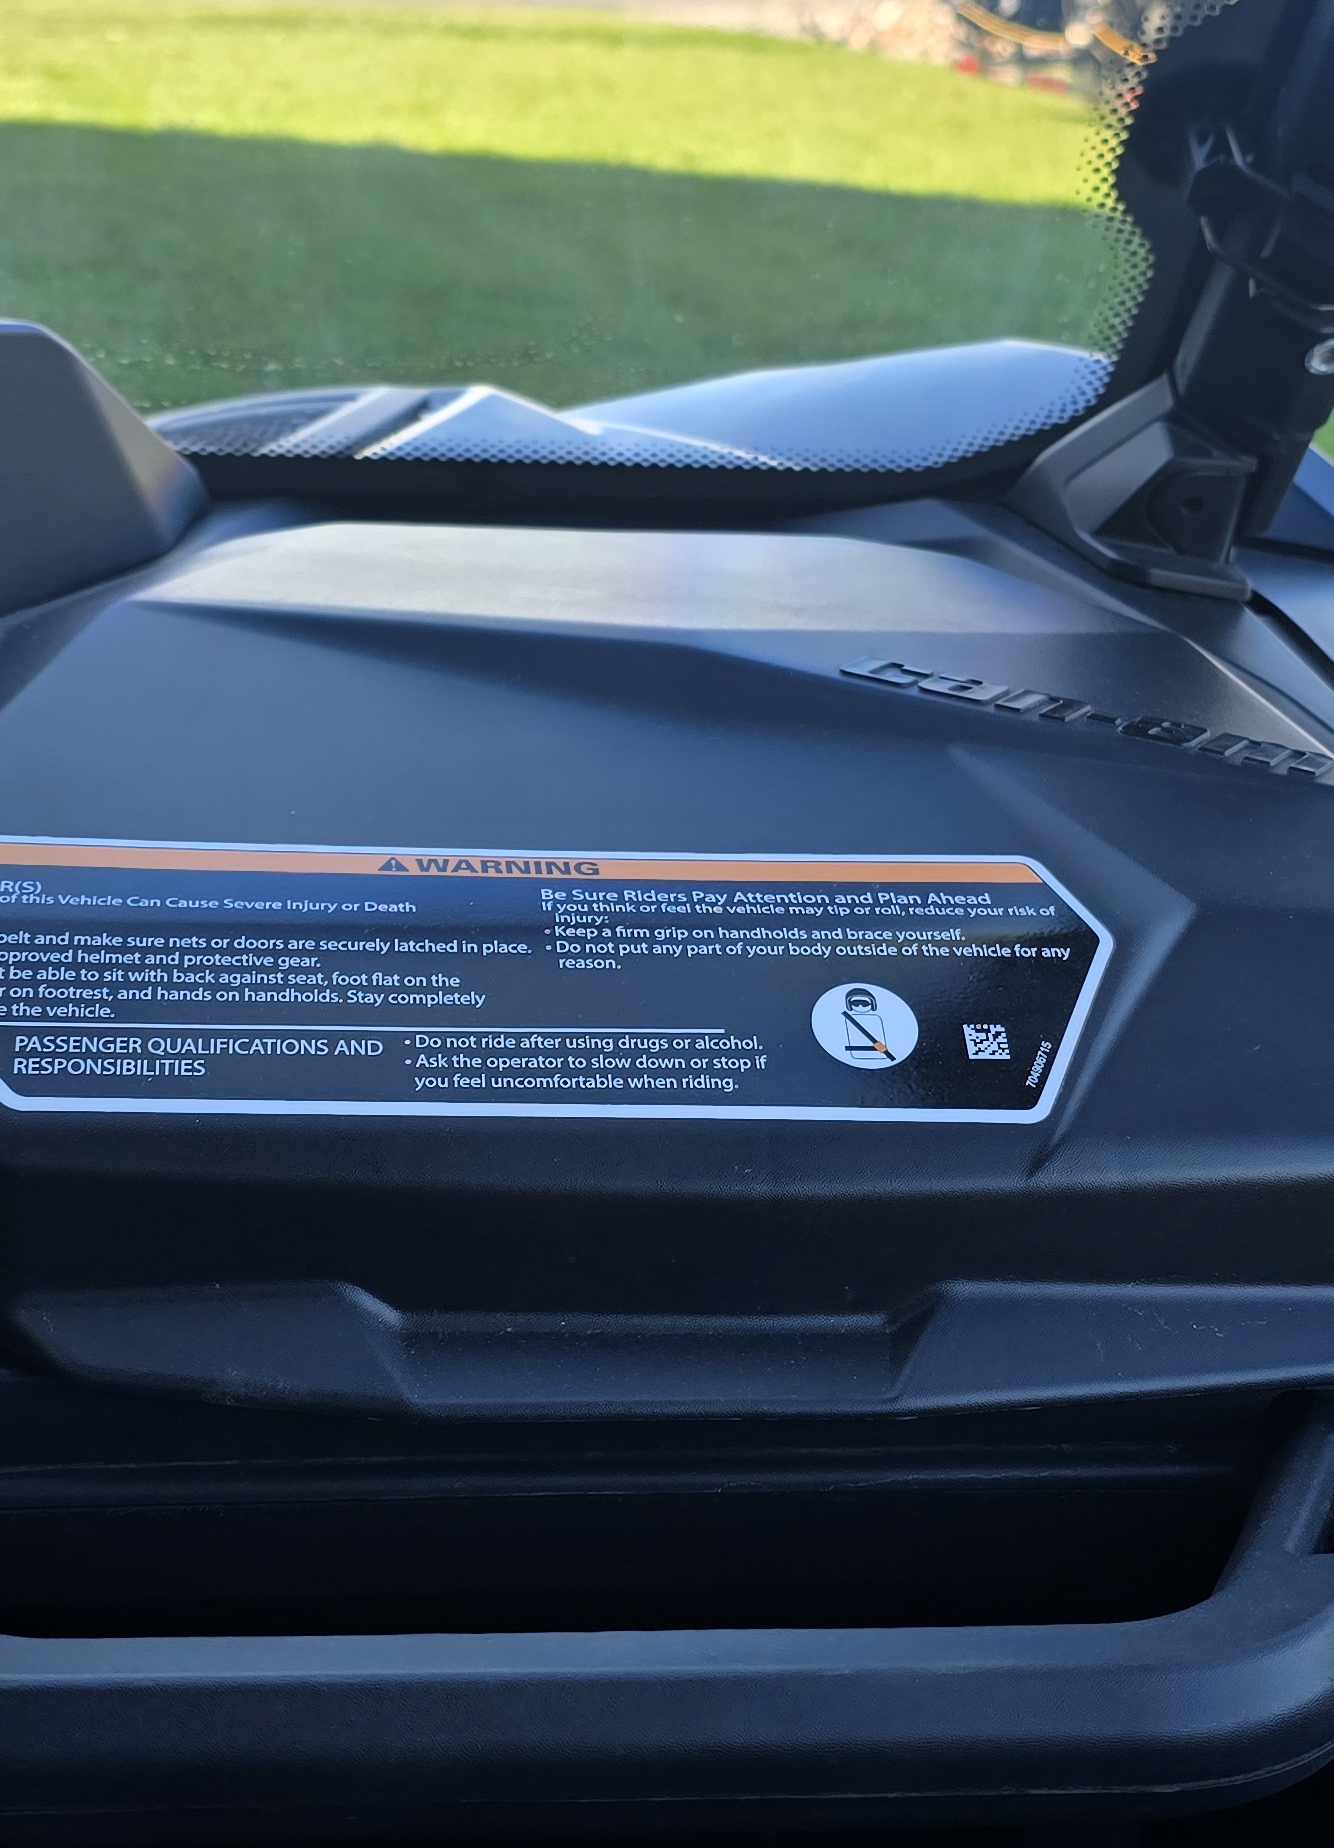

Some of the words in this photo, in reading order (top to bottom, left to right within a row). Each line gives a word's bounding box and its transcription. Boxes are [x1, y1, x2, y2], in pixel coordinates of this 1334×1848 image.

[415, 858, 600, 876] WARNING
[0, 893, 17, 903] of
[22, 893, 54, 904] this
[58, 895, 122, 905] Vehicle
[127, 897, 160, 906] Can
[166, 898, 218, 908] Cause
[224, 899, 282, 909] Severe
[365, 902, 416, 912] Death
[541, 889, 566, 901] Be
[572, 889, 618, 901] Sure
[624, 890, 687, 902] Riders
[692, 891, 727, 906] Pay
[734, 892, 829, 903] Attention
[835, 892, 873, 904] and
[878, 892, 921, 904] Plan
[928, 893, 991, 905] Ahead
[542, 901, 552, 911] If
[555, 904, 588, 914] you
[592, 902, 636, 912] think
[661, 903, 691, 913] feel
[695, 902, 722, 913] the
[726, 904, 784, 914] vehicle
[789, 907, 823, 916] may
[827, 905, 850, 916] tip
[875, 905, 905, 916] roll,
[909, 905, 964, 915] reduce
[967, 908, 1003, 917] your
[1008, 906, 1036, 916] risk
[1040, 906, 1055, 916] of
[34, 932, 69, 945] and
[74, 933, 123, 946] make
[127, 937, 164, 947] sure
[169, 936, 206, 947] nets
[211, 939, 230, 948] or
[234, 936, 284, 949] doors
[288, 940, 315, 949] are
[320, 938, 390, 954] securely
[395, 939, 457, 952] latched
[462, 941, 477, 952] in
[483, 940, 532, 956] place.
[555, 926, 597, 940] Keep
[602, 929, 611, 938] a
[616, 926, 649, 937] firm
[654, 927, 688, 940] grip
[692, 930, 714, 938] on
[718, 927, 807, 939] handholds
[812, 928, 842, 940] and
[846, 928, 892, 940] brace
[896, 929, 965, 943] yourself.
[78, 950, 141, 964] helmet
[145, 952, 179, 964] and
[184, 954, 274, 968] protective
[278, 957, 320, 969] gear.
[556, 941, 581, 952] Do
[586, 942, 614, 952] not
[619, 943, 648, 956] put
[653, 945, 682, 957] any
[687, 944, 722, 957] part
[726, 942, 742, 954] of
[746, 946, 784, 957] your
[789, 943, 831, 958] body
[836, 943, 897, 955] outside
[902, 943, 918, 955] of
[922, 944, 949, 956] the
[953, 944, 1011, 957] vehicle
[1014, 944, 1037, 957] for
[1042, 948, 1070, 960] any
[559, 959, 621, 969] reason.
[9, 966, 33, 979] be
[37, 967, 76, 980] able
[80, 969, 99, 981] to
[104, 969, 124, 981] sit
[128, 969, 167, 982] with
[173, 969, 215, 983] back
[219, 971, 284, 986] against
[288, 973, 328, 988] seat,
[332, 972, 368, 985] foot
[372, 972, 400, 986] flat
[404, 977, 426, 986] on
[431, 974, 460, 987] the
[10, 988, 33, 997] on
[38, 984, 113, 1002] footrest,
[117, 986, 152, 999] and
[157, 987, 211, 1000] hands
[216, 991, 239, 1001] on
[245, 988, 343, 1003] handholds.
[347, 990, 384, 1006] Stay
[388, 991, 485, 1008] completely
[11, 1002, 42, 1016] the
[46, 1003, 114, 1017] vehicle.
[15, 1036, 141, 1053] PASSENGER
[148, 1038, 328, 1055] QUALIFICATIONS
[334, 1040, 383, 1055] AND
[416, 1035, 443, 1047] Do
[447, 1036, 477, 1048] not
[482, 1035, 515, 1048] ride
[520, 1034, 561, 1048] after
[566, 1036, 613, 1052] using
[618, 1035, 668, 1054] drugs
[673, 1039, 691, 1049] or
[695, 1036, 763, 1049] alcohol.
[14, 1058, 205, 1076] RESPONSIBILITIES
[416, 1054, 448, 1067] Ask
[452, 1054, 482, 1067] the
[487, 1056, 564, 1071] operator
[568, 1056, 586, 1068] to
[591, 1053, 631, 1068] slow
[636, 1055, 685, 1068] down
[690, 1058, 708, 1068] or
[713, 1057, 751, 1072] stop
[755, 1055, 766, 1069] if
[415, 1077, 448, 1091] you
[453, 1074, 485, 1087] feel
[492, 1074, 623, 1088] uncomfortable
[628, 1074, 677, 1088] when
[682, 1074, 738, 1092] riding.
